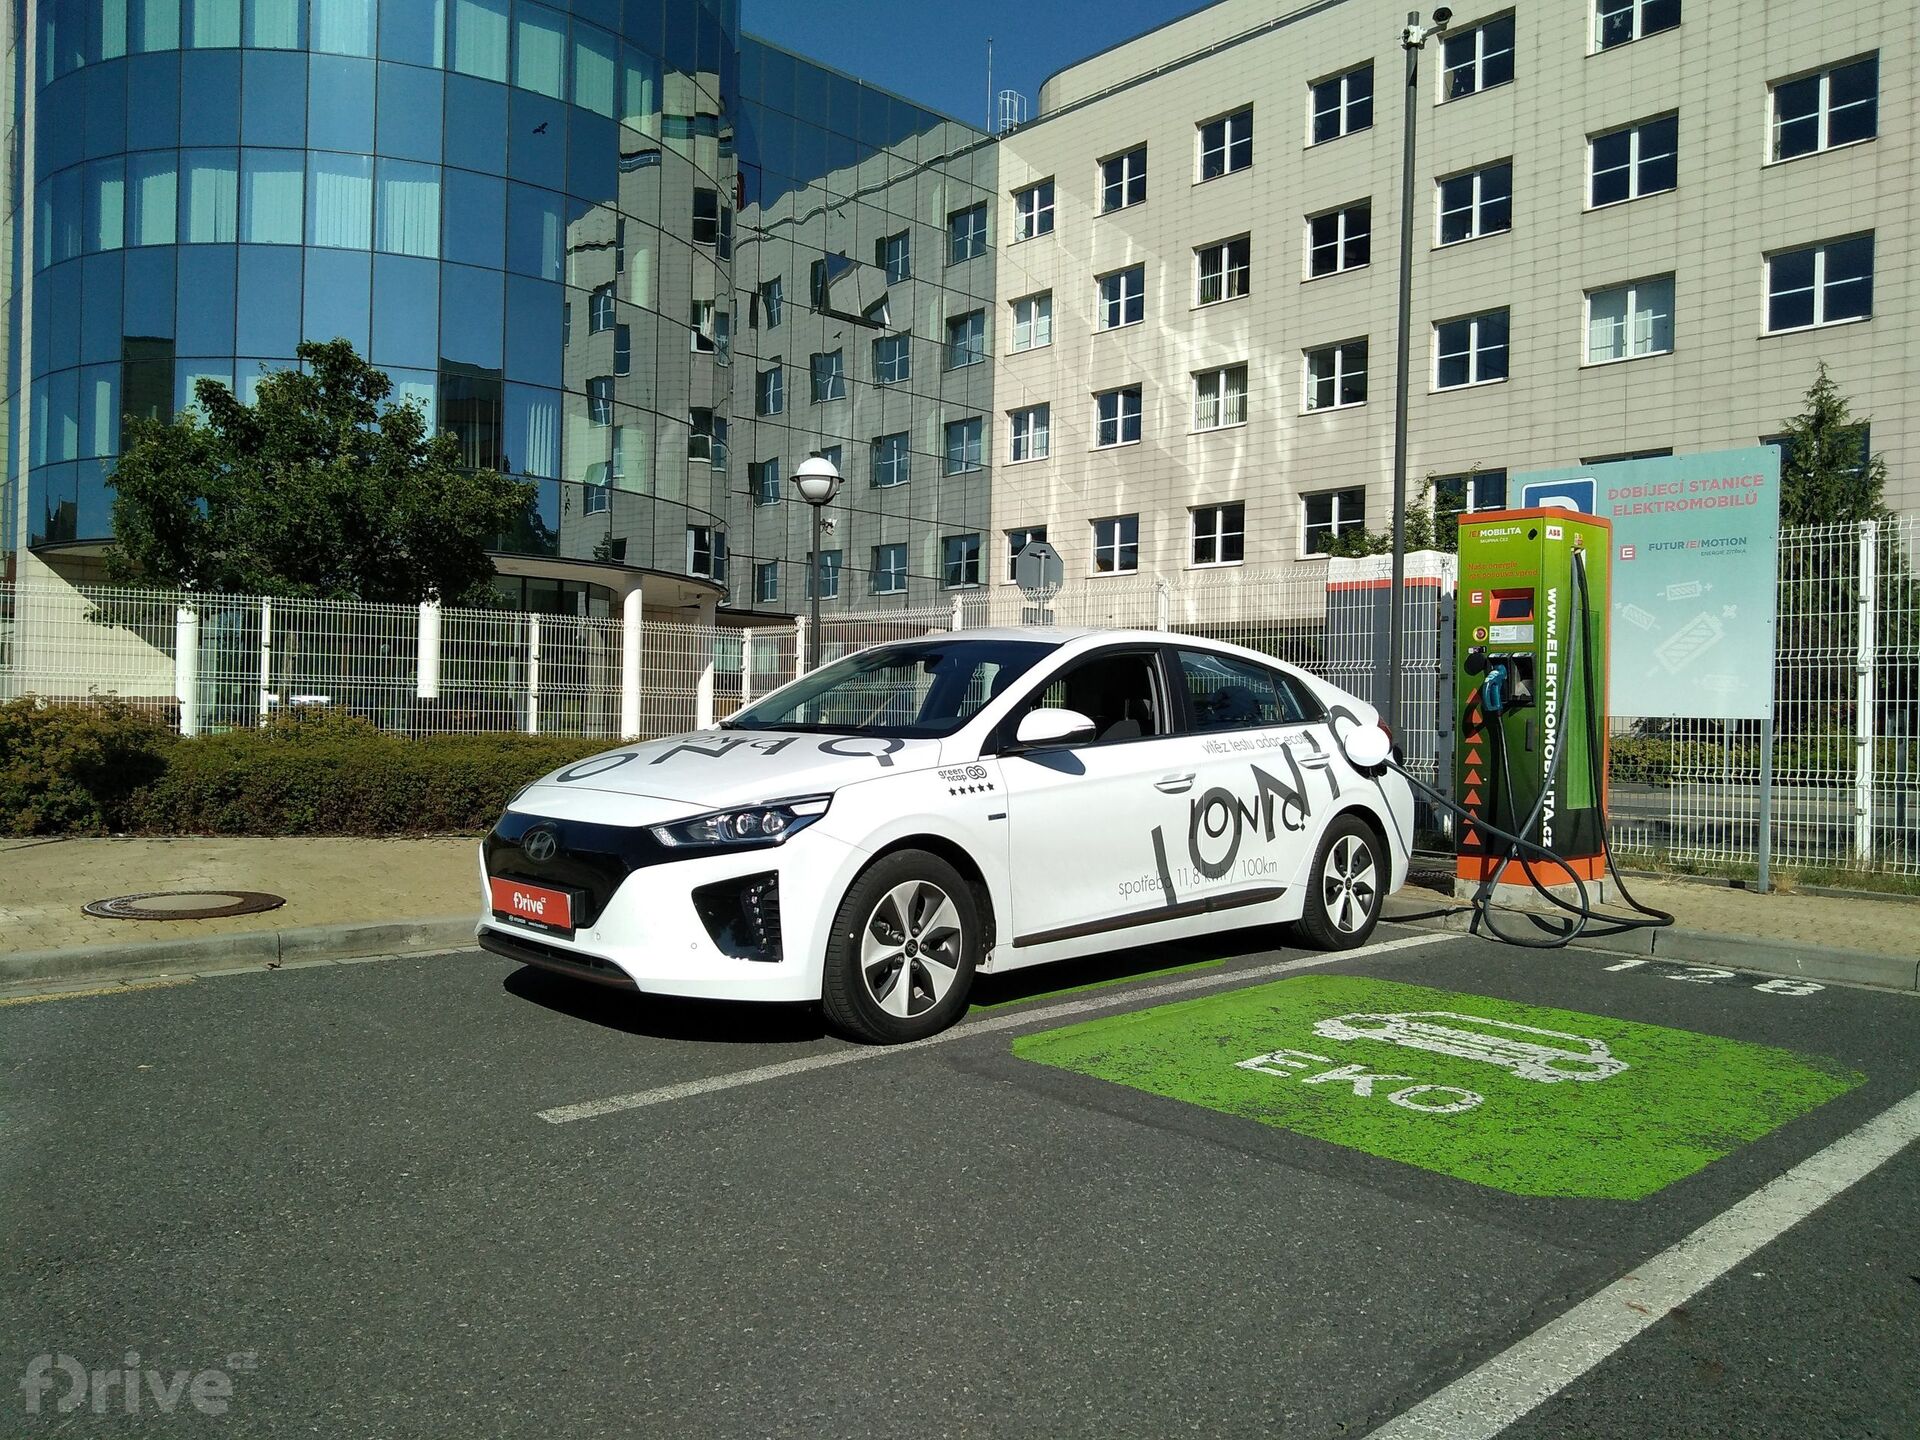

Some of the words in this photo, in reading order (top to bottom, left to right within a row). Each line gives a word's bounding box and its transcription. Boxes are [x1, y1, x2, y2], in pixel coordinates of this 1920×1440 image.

[1607, 479, 1685, 501] DOBÍJECÍ
[1688, 474, 1765, 494] STANICE
[1612, 489, 1758, 517] ELEKTROMOBILŮ
[1548, 529, 1561, 537] ABB
[1202, 739, 1231, 755] vítěz
[1228, 738, 1255, 752] testu
[938, 767, 965, 780] green
[946, 774, 968, 783] ncap
[1118, 869, 1173, 901] spotřeba
[1177, 866, 1201, 889] 11,8
[1241, 856, 1278, 878] 100km
[1234, 1048, 1484, 1114] EKO
